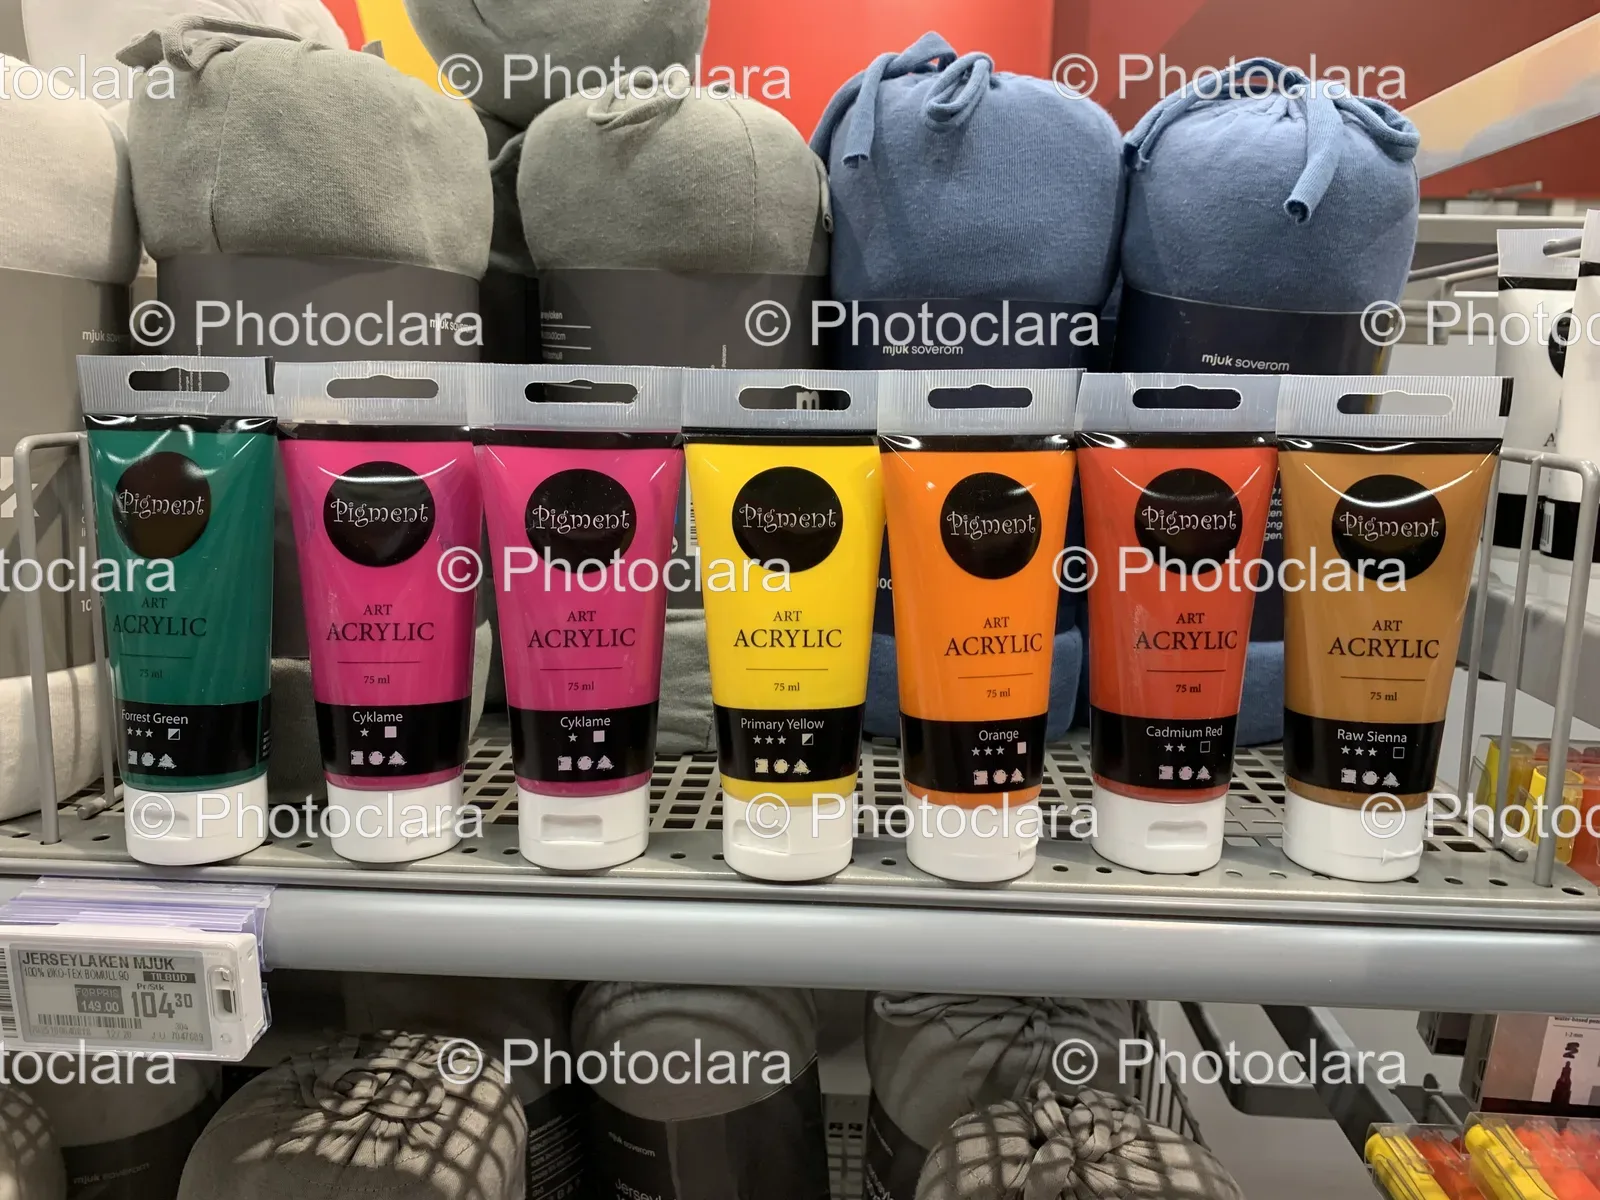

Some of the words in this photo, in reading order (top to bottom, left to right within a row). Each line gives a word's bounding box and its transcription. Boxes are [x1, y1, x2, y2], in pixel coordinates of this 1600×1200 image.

[82, 329, 105, 343] mjuk
[882, 344, 909, 357] mjuk
[911, 344, 963, 356] soverom
[1201, 352, 1233, 368] mjuk
[1235, 357, 1290, 372] soverom
[119, 489, 204, 519] Pigment
[330, 498, 429, 528] Pigment
[532, 504, 630, 535] Pigment
[739, 503, 837, 534] Pigment
[946, 510, 1036, 541] Pigment
[1141, 505, 1237, 535] Pigment
[1339, 511, 1440, 542] Pigment
[141, 597, 168, 609] ART
[363, 604, 393, 616] ART
[567, 610, 597, 622] ART
[773, 610, 803, 622] ART
[983, 617, 1010, 629] ART
[1176, 612, 1205, 625] ART
[113, 614, 207, 637] ACRYLIC
[326, 622, 435, 641] ACRYLIC
[1372, 620, 1403, 631] ART
[527, 628, 636, 648] ACRYLIC
[733, 628, 842, 648] ACRYLIC
[1134, 630, 1238, 650] ACRYLIC
[944, 633, 1043, 657] ACRYLIC
[1327, 637, 1440, 659] ACRYLIC
[364, 675, 375, 684] 75
[377, 675, 390, 684] ml
[568, 682, 579, 691] 75
[581, 681, 594, 691] ml
[774, 683, 785, 692] 75
[787, 682, 800, 692] ml
[986, 689, 997, 698] 75
[1000, 688, 1011, 698] ml
[1176, 684, 1187, 693] 75
[1189, 684, 1202, 693] ml
[1370, 692, 1382, 701] 75
[1384, 692, 1398, 701] ml
[121, 709, 150, 723] Forrest
[153, 712, 189, 725] Green
[352, 711, 403, 724] Cyklame
[560, 716, 611, 729] Cyklame
[740, 717, 785, 732] Primary
[787, 717, 825, 730] Yellow
[978, 729, 1019, 742] Orange
[1146, 726, 1203, 738] Cadmium
[1205, 725, 1223, 737] Red
[1337, 728, 1364, 741] Raw
[1367, 730, 1408, 743] Sienna
[22, 952, 129, 969] JERSEYLAKEN
[133, 956, 175, 971] MJUK
[24, 967, 45, 978] 100%
[150, 972, 188, 982] TILBUD
[81, 1001, 119, 1012] 149.00
[131, 991, 175, 1018] 104
